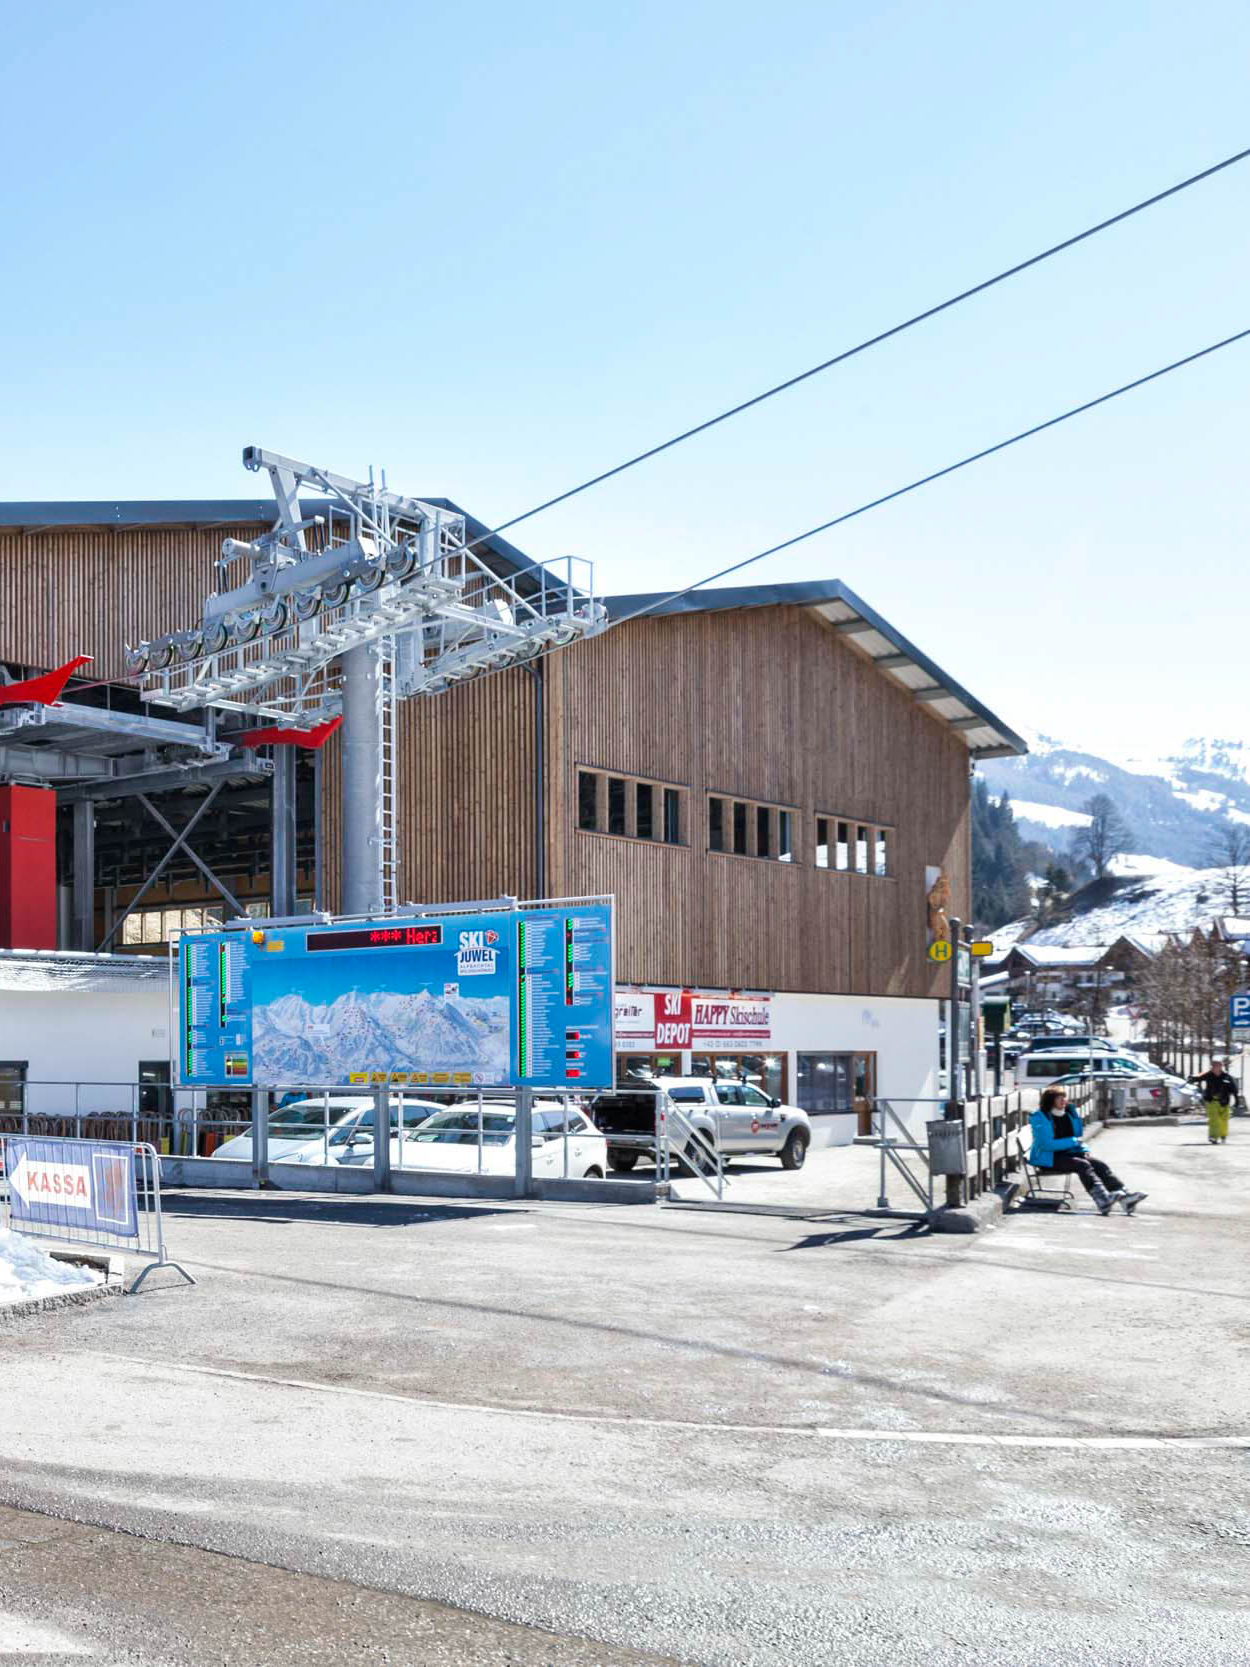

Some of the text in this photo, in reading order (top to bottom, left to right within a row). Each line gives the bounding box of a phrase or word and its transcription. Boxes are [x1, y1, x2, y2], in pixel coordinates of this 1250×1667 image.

[459, 931, 484, 949] SKI
[460, 949, 494, 963] JUWEL
[935, 944, 947, 959] H
[664, 992, 682, 1016] SKI
[1233, 997, 1250, 1017] P
[694, 1004, 730, 1025] HAPPY
[656, 1023, 691, 1045] DEPOT
[27, 1171, 87, 1197] KASSA
